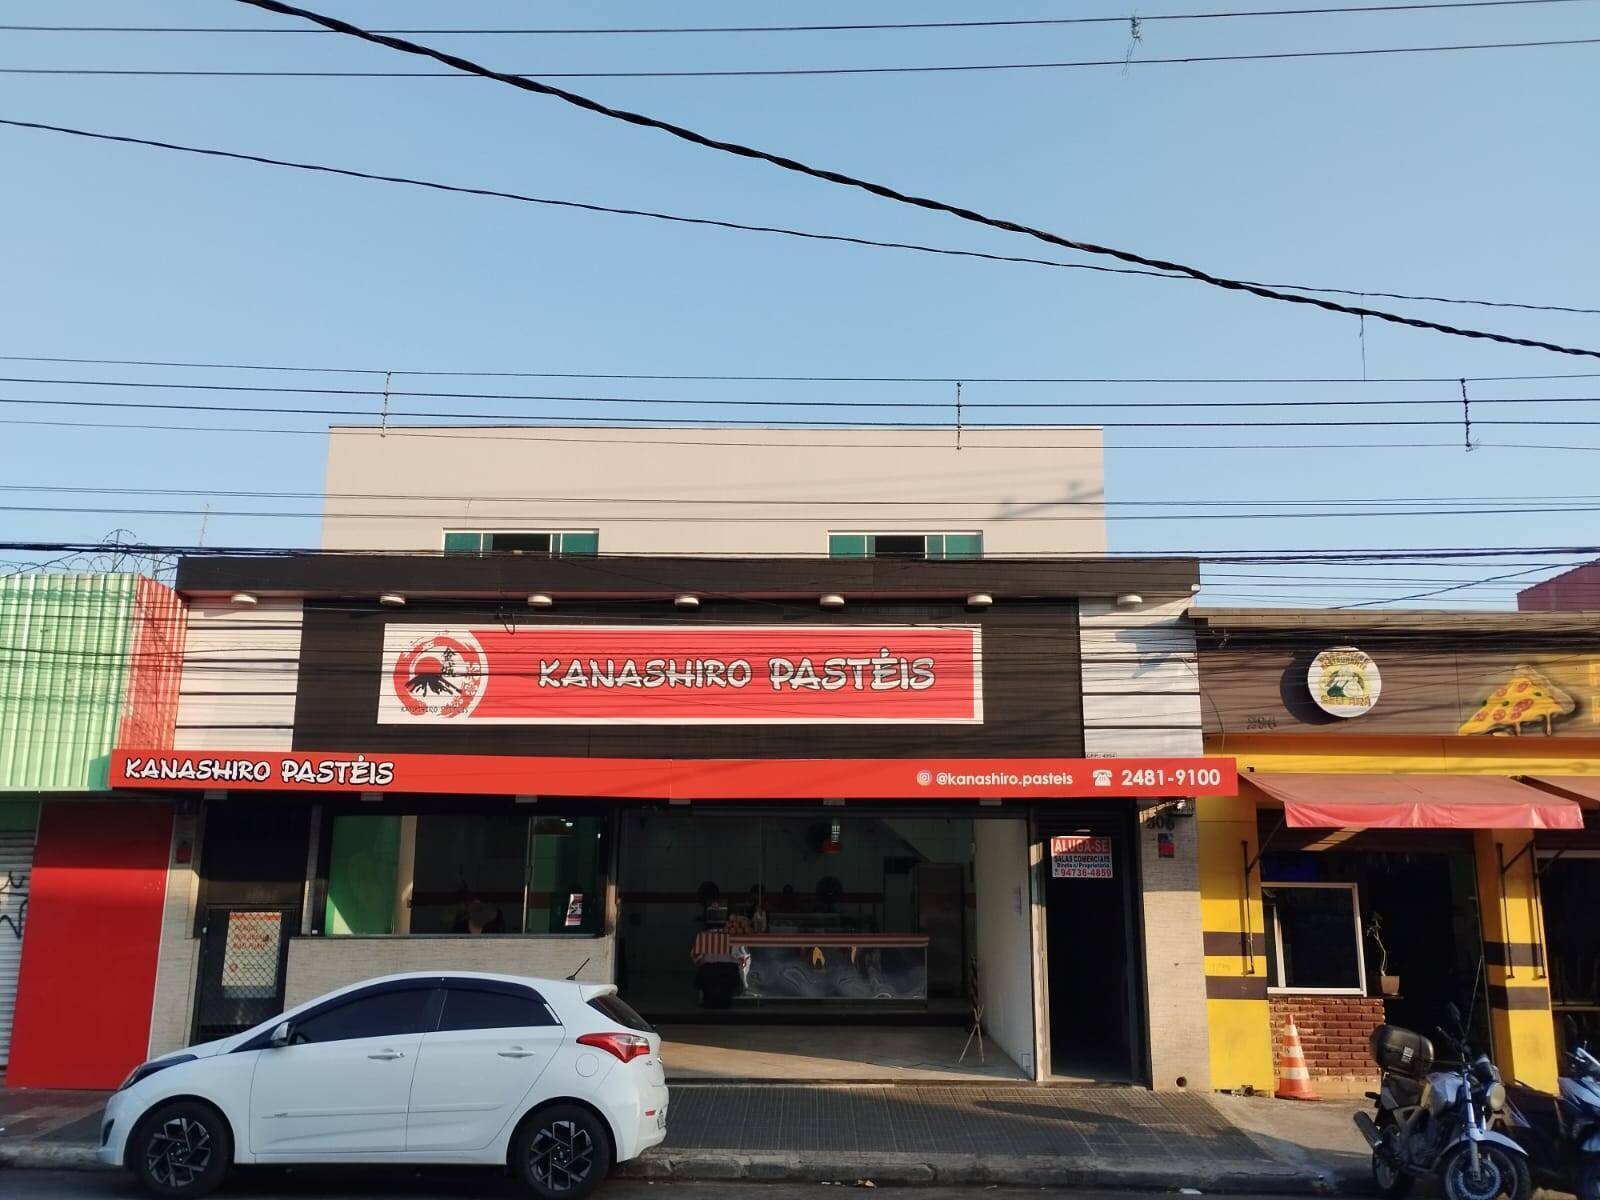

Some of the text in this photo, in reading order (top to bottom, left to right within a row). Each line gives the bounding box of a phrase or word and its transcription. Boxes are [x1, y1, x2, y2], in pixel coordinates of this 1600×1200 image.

[538, 646, 937, 691] KANASHIRO PASTÉIS
[125, 755, 394, 785] KANASHIRO PASTÉIS
[936, 769, 1221, 788] @kanashiro.pasteis 2481-9100
[1055, 839, 1109, 853] ALUGA-SE
